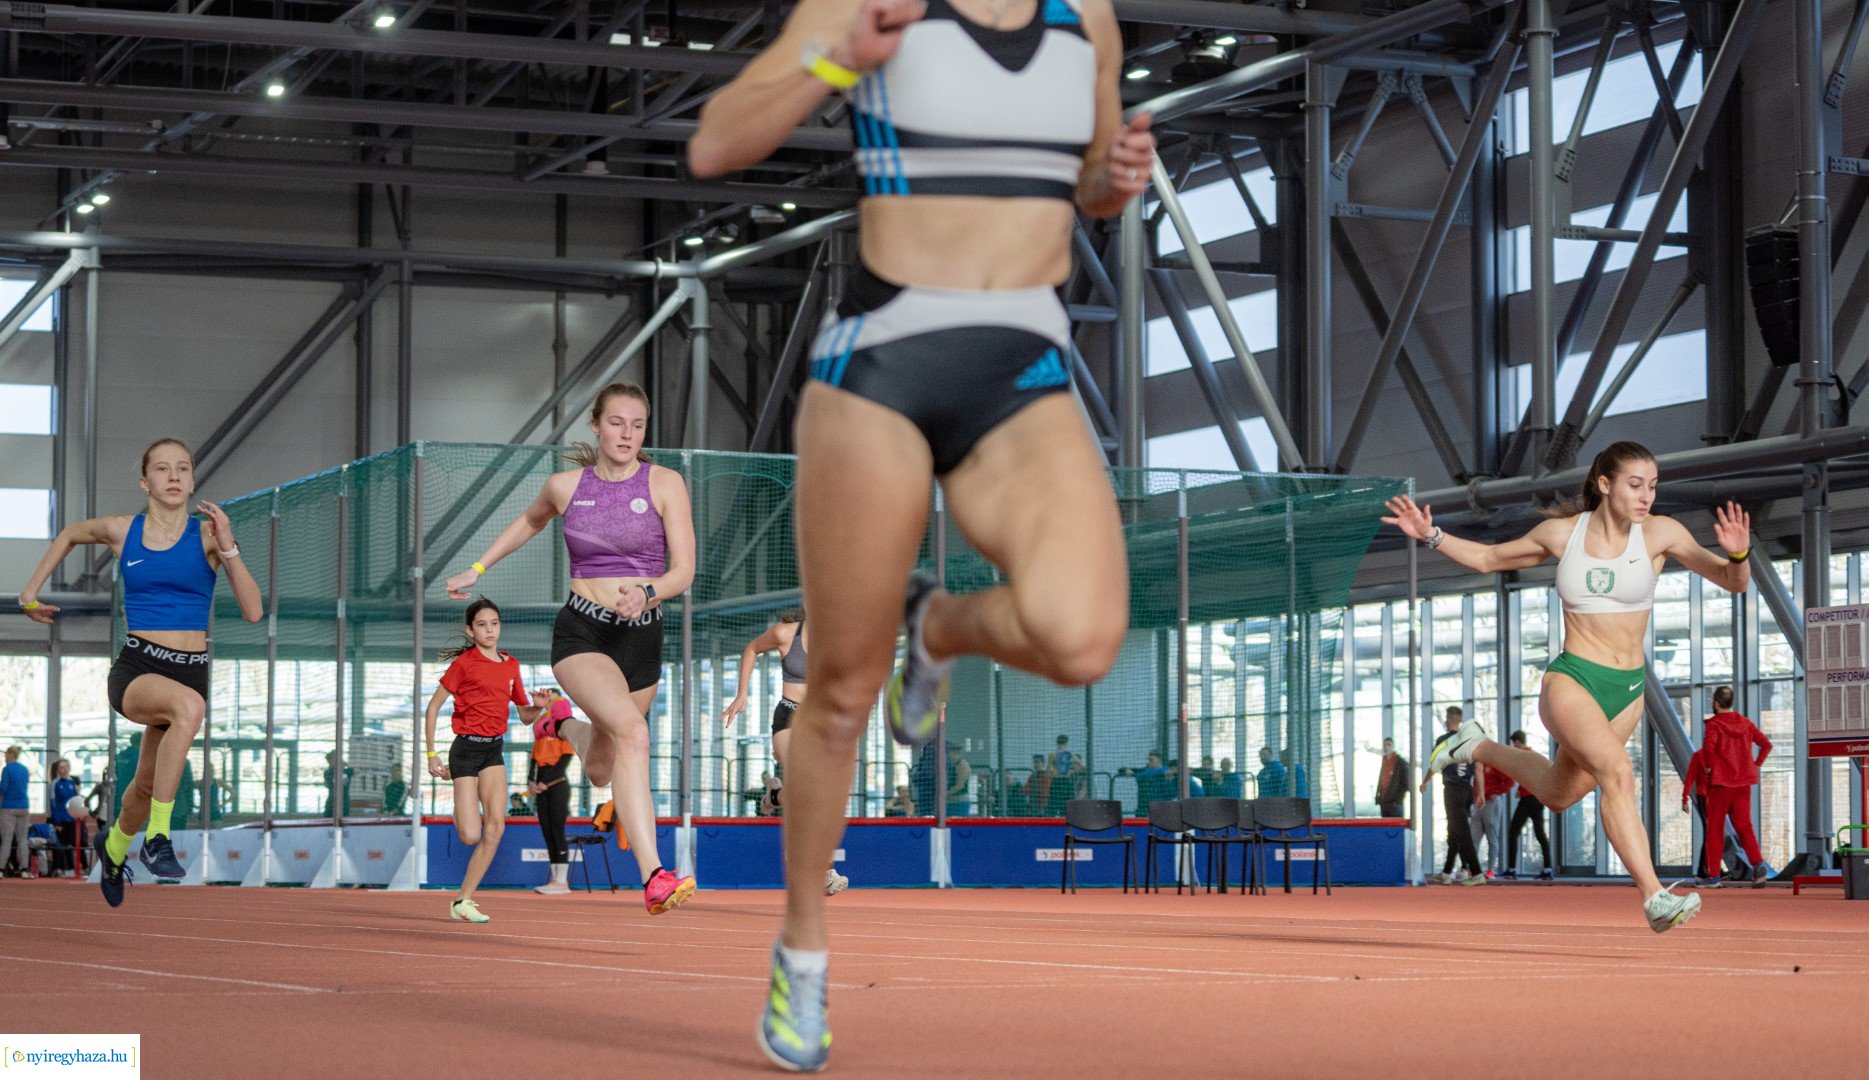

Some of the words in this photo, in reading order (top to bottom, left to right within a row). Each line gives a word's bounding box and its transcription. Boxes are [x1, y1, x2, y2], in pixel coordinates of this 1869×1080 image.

[569, 594, 614, 623] NIKE
[1808, 609, 1859, 623] COMPETITOR
[125, 636, 140, 648] O
[143, 644, 188, 664] NIKE
[781, 699, 799, 711] PRO
